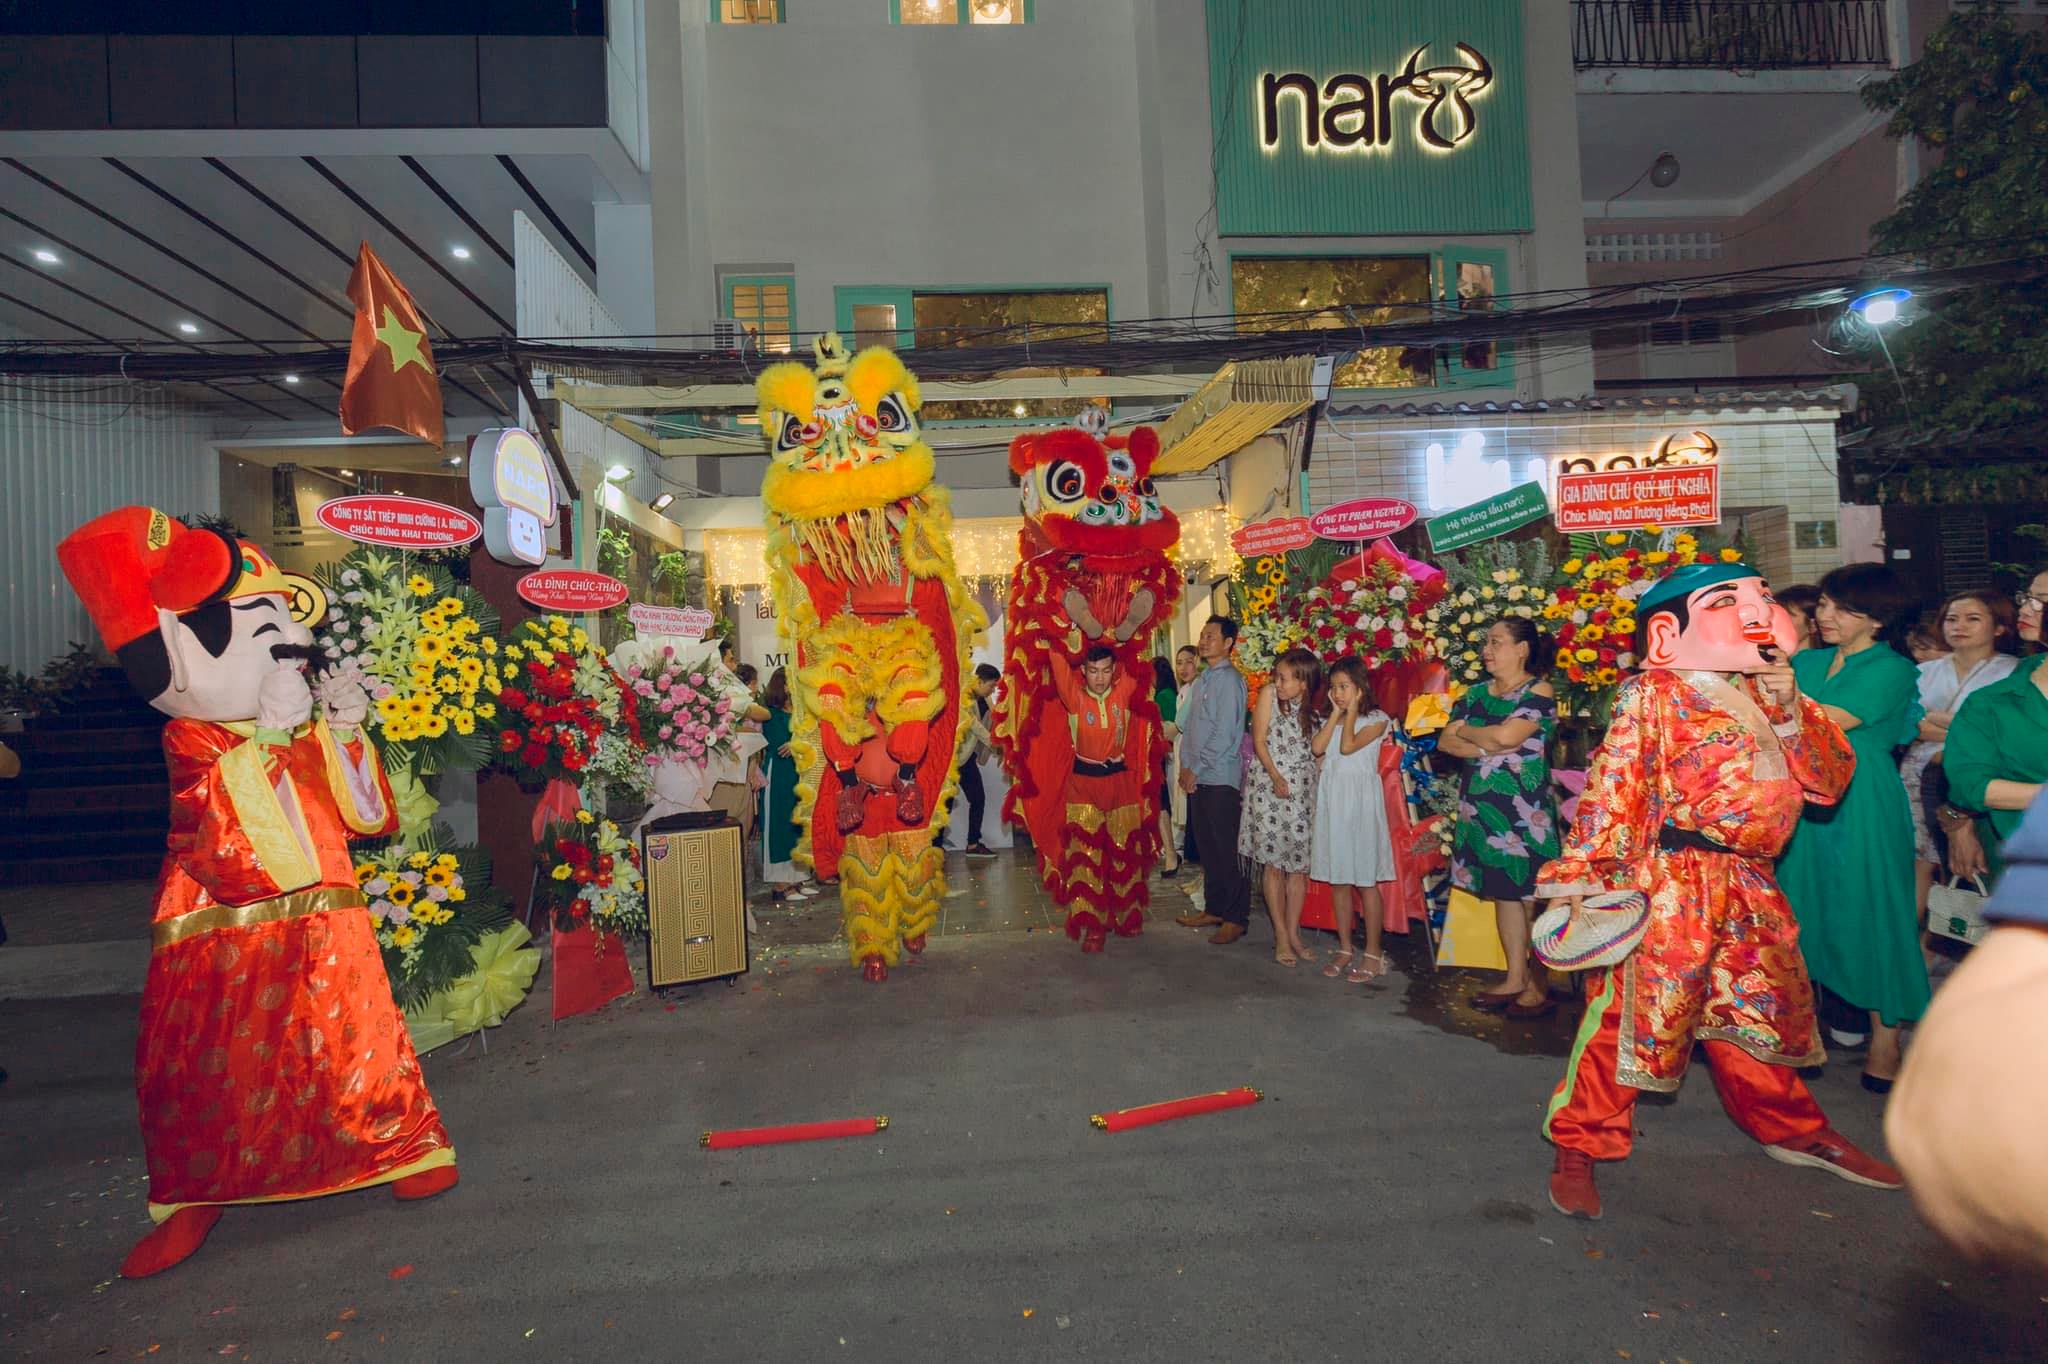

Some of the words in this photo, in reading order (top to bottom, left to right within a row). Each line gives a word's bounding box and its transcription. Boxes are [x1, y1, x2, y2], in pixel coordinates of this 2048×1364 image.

[1563, 486, 1581, 504] GIA
[1582, 480, 1607, 502] ĐÌNH
[1609, 476, 1631, 501] CHÚ
[332, 503, 352, 520] CÔNG
[352, 508, 362, 520] TY
[1315, 513, 1337, 525] CÔNG
[1338, 512, 1349, 522] TY
[1563, 509, 1586, 523] Chúc
[1588, 507, 1612, 524] Mừng
[1614, 507, 1633, 521] Khai
[1690, 501, 1711, 515] Phát
[1446, 520, 1460, 531] Hệ
[1461, 511, 1488, 525] thống
[350, 524, 373, 535] CHÚC
[401, 528, 421, 539] KHAI
[526, 578, 542, 589] GIA
[545, 576, 568, 590] ĐÌNH
